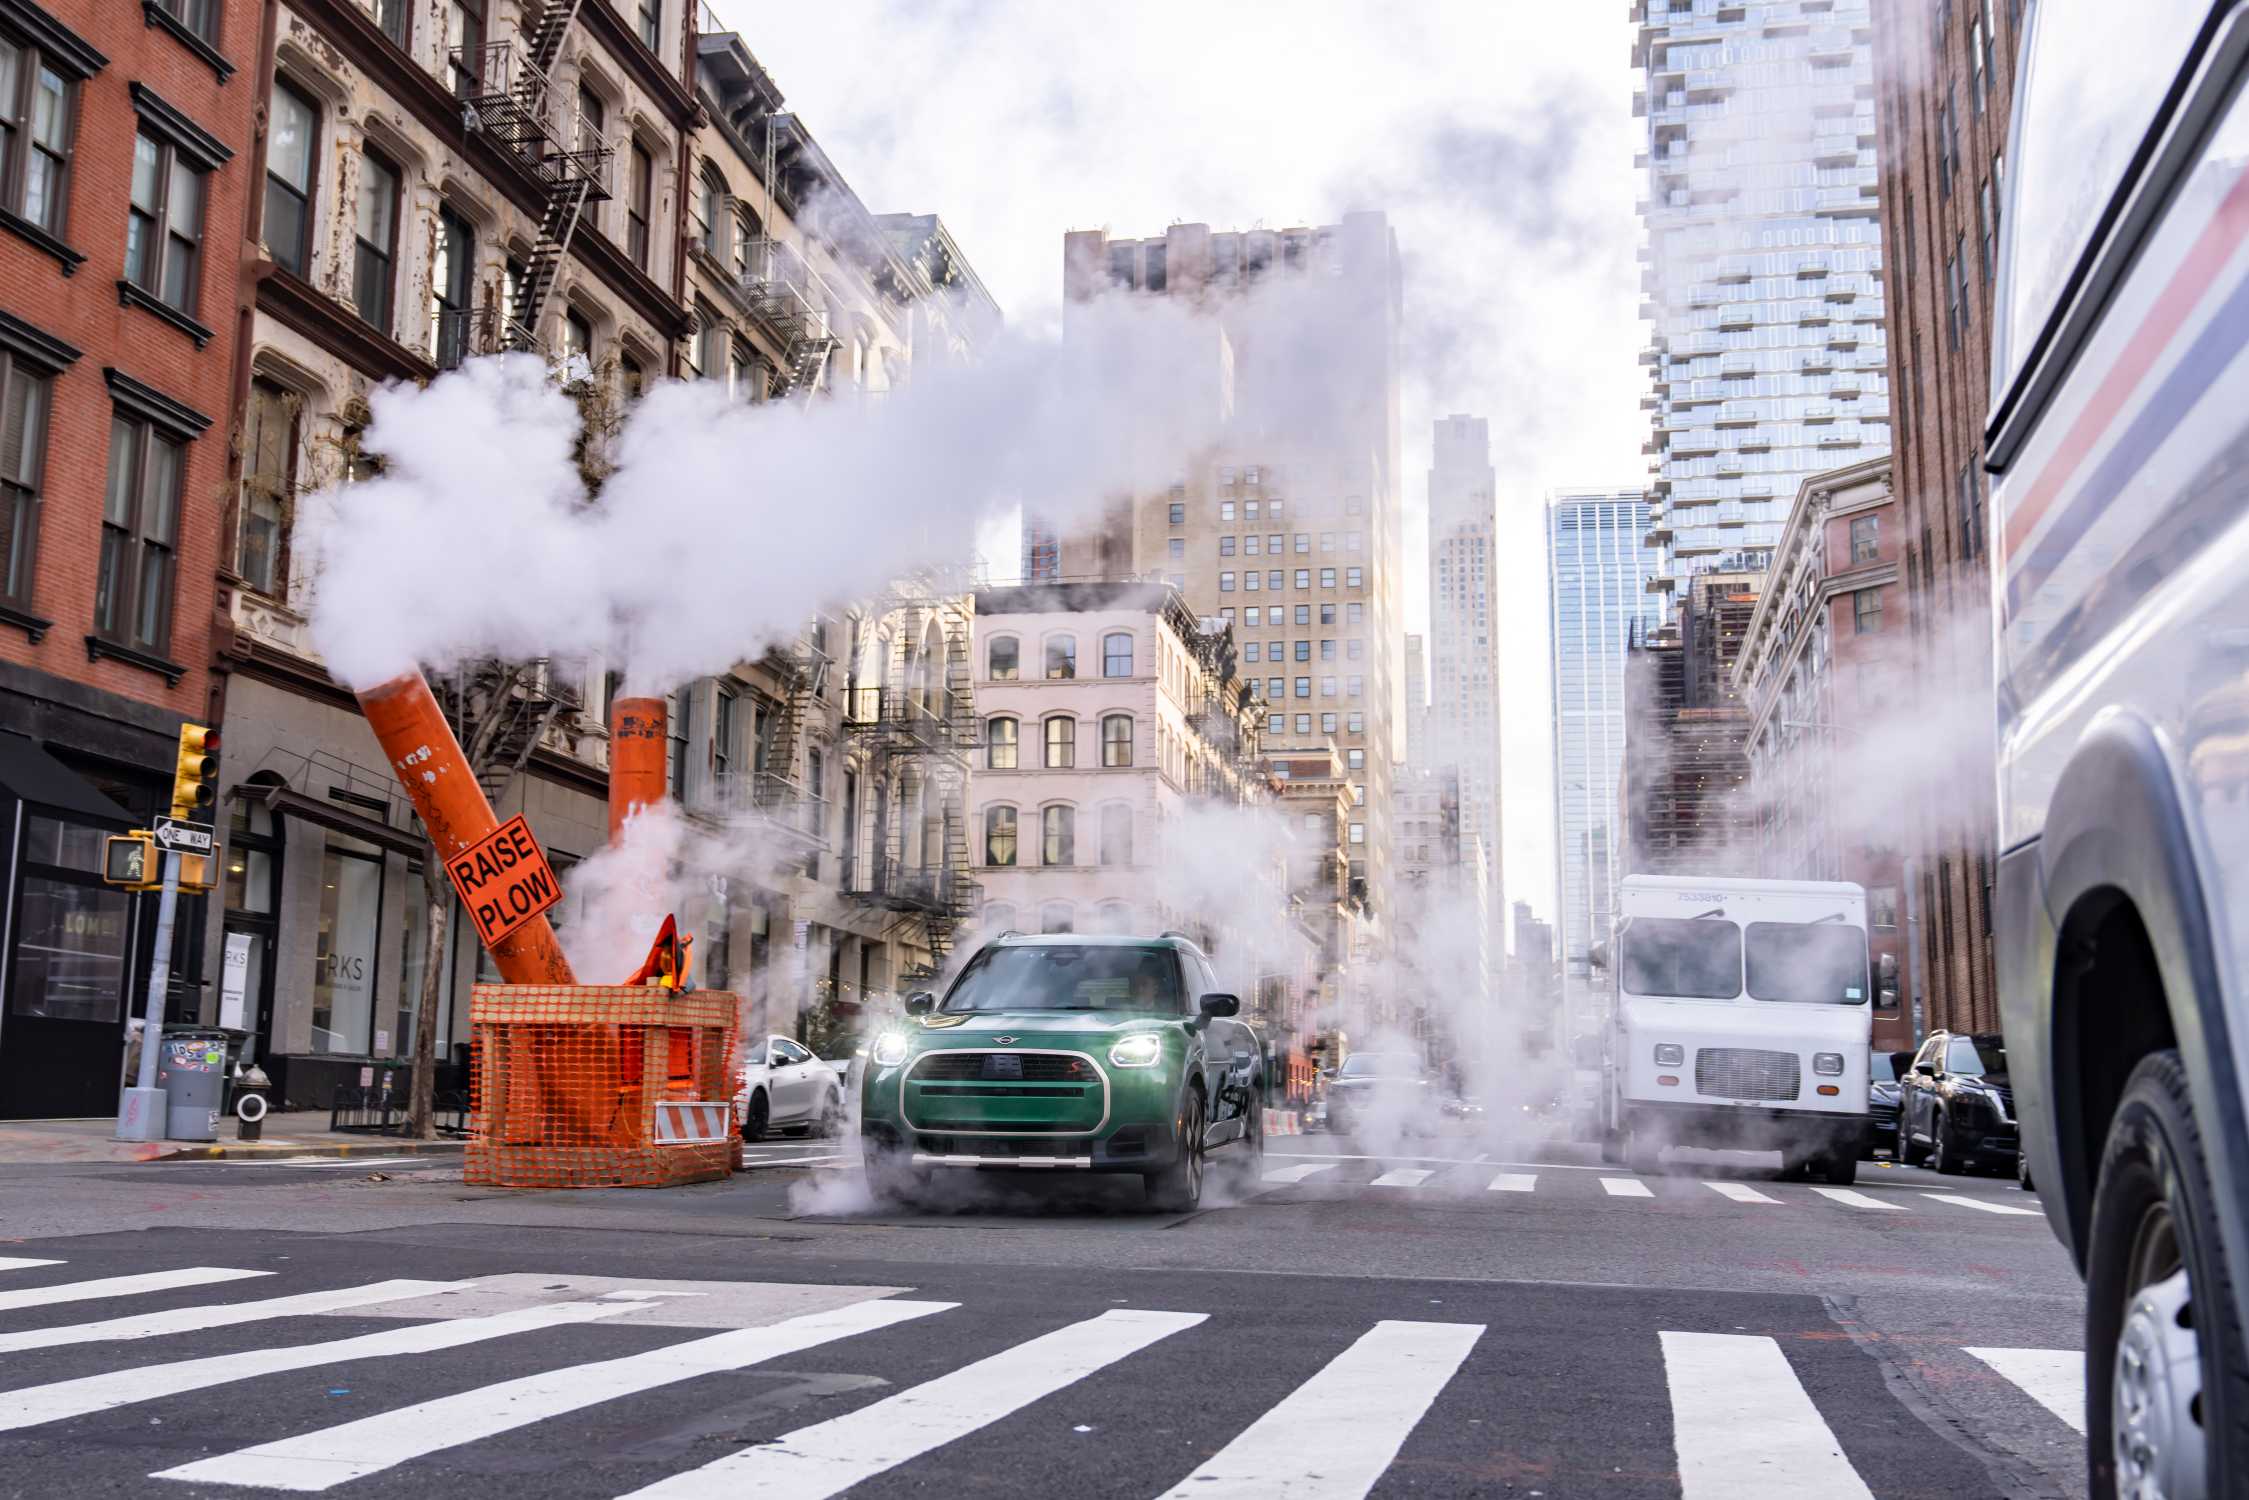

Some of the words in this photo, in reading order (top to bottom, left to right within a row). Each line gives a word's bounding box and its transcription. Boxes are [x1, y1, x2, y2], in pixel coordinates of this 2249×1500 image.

[162, 828, 181, 842] ONE
[190, 832, 209, 846] WAY
[455, 825, 534, 895] RAISE
[478, 867, 551, 937] PLOW
